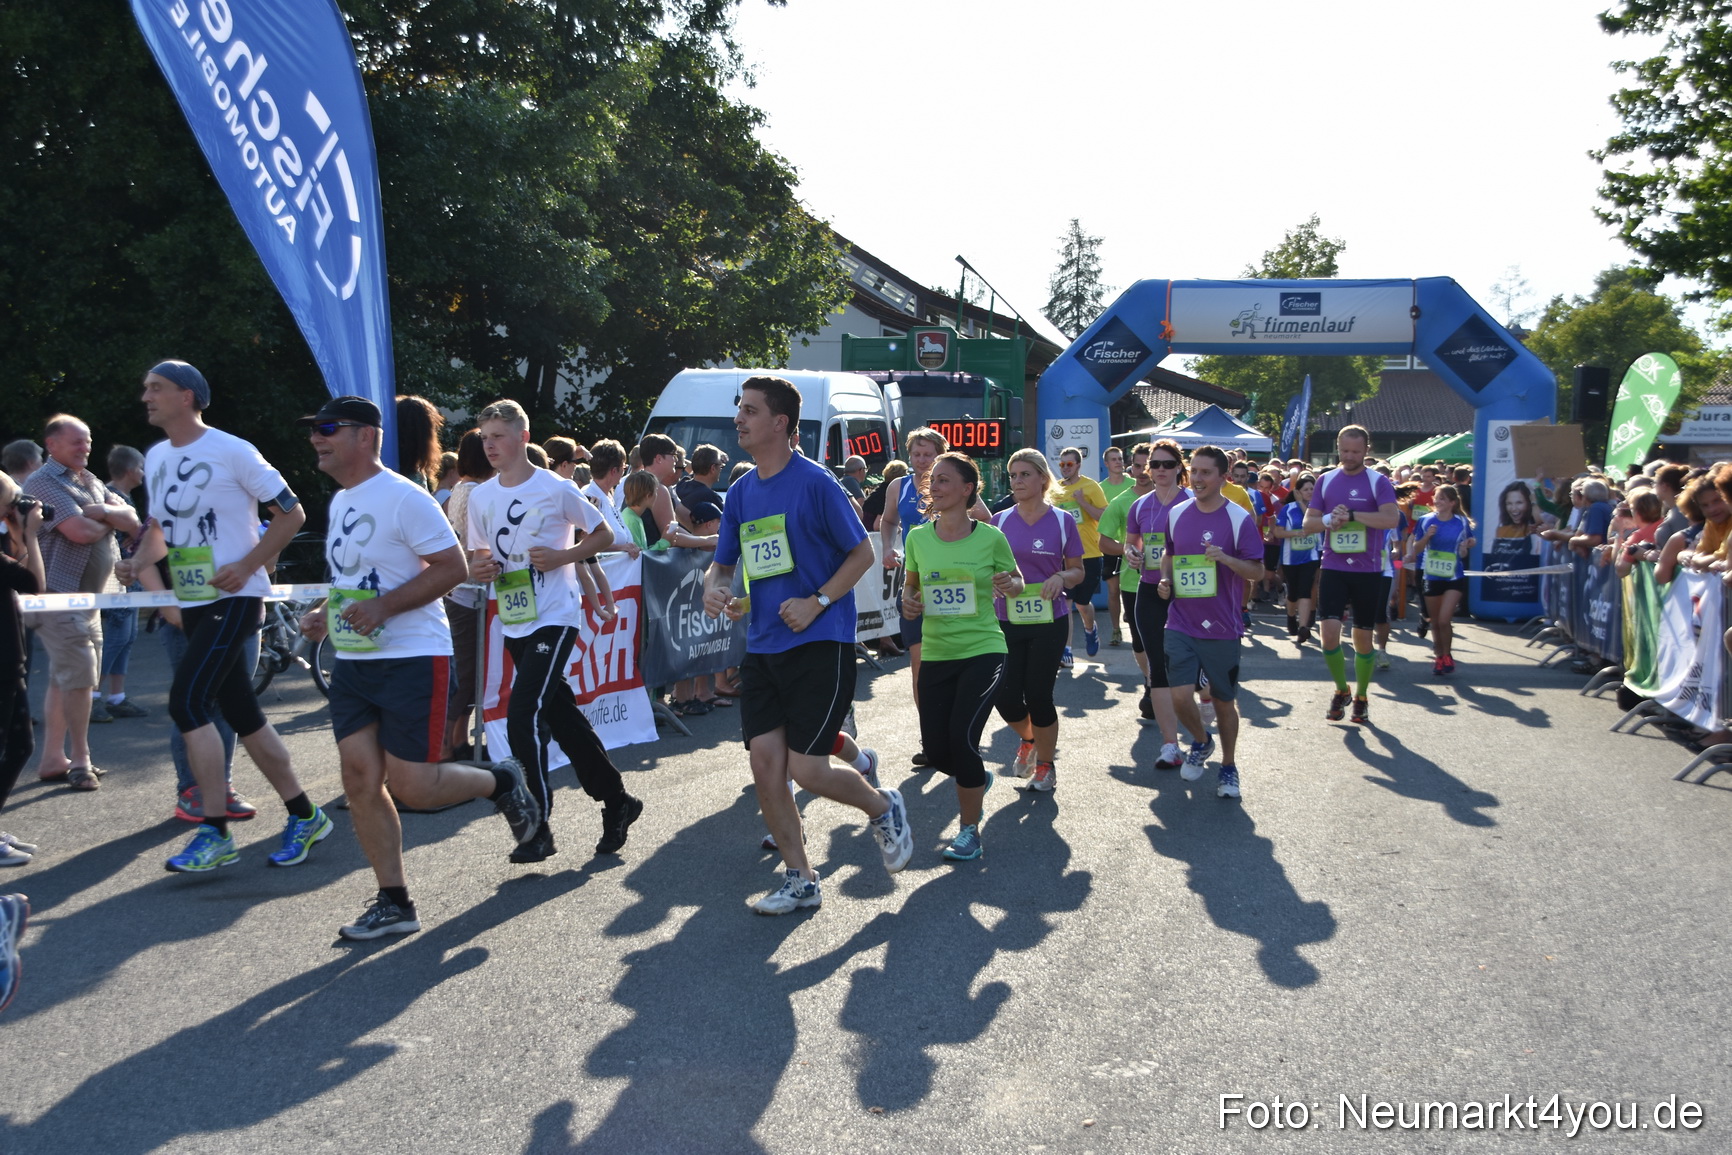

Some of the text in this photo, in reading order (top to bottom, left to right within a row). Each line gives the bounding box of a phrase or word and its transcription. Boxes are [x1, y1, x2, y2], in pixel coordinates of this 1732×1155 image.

[1264, 316, 1356, 333] firmenlauf
[1094, 349, 1141, 359] Fischer
[1641, 394, 1669, 426] AOK
[1693, 411, 1731, 421] Jura
[929, 422, 1000, 447] 00303
[1611, 416, 1643, 451] AOK
[1175, 438, 1249, 447] ww.fischer-automobile.de
[1293, 536, 1313, 545] 1126
[1336, 533, 1359, 545] 512
[751, 539, 781, 563] 735
[1428, 559, 1452, 571] 1115
[177, 568, 206, 587] 345
[1180, 571, 1207, 586] 513
[504, 590, 528, 612] 346
[932, 588, 966, 605] 335
[1015, 599, 1043, 614] 515
[334, 613, 361, 634] 34
[688, 636, 731, 661] AUTOMOBILE
